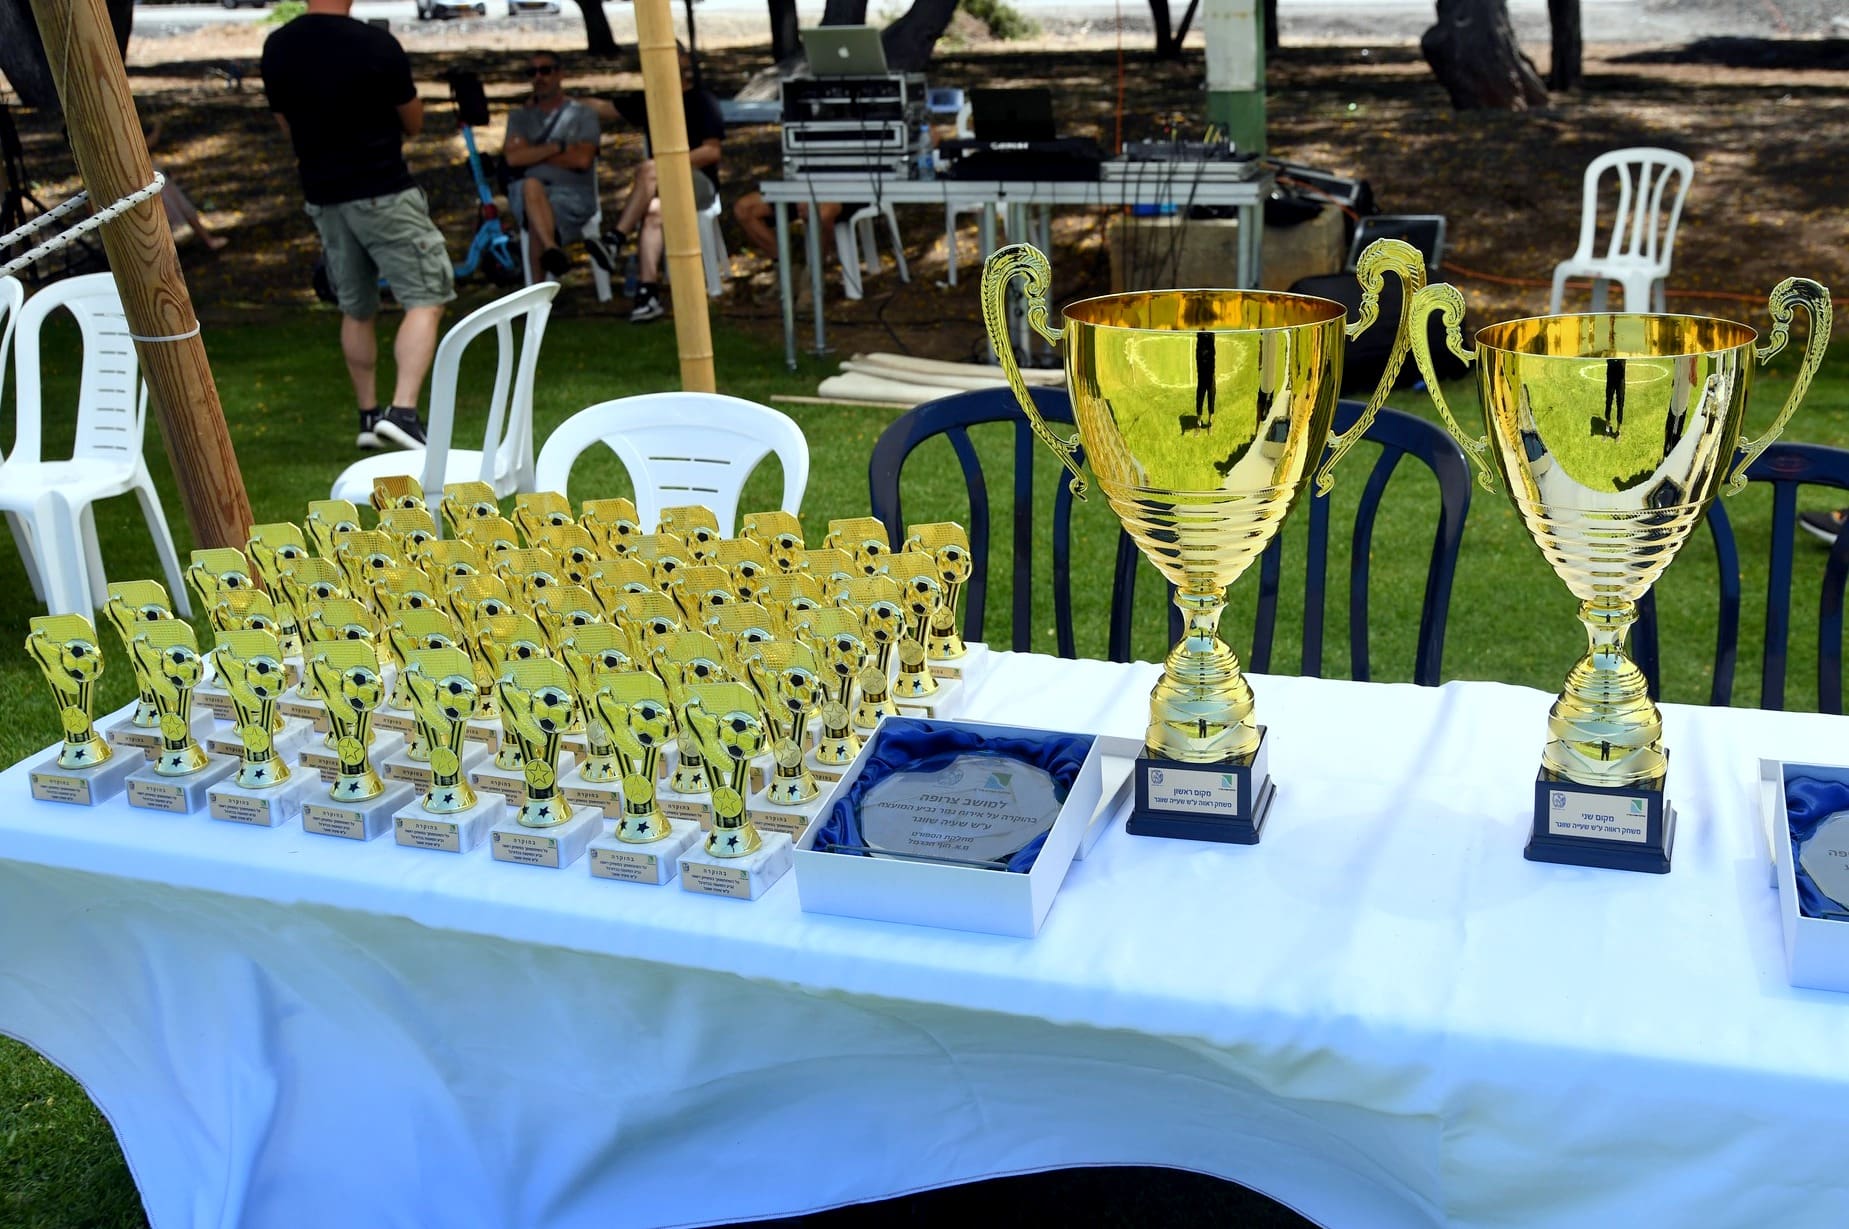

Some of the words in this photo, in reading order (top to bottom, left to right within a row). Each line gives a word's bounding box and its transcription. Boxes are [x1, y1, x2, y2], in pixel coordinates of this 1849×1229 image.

[1173, 788, 1193, 796] ראשון
[1194, 790, 1212, 798] מקום
[920, 794, 960, 804] צרופה
[878, 801, 914, 811] המועצה
[962, 798, 1008, 809] למושב
[915, 805, 937, 813] גביע
[987, 811, 999, 820] על
[1001, 814, 1037, 824] בהוקרה
[1581, 812, 1594, 820] שני
[1596, 815, 1615, 823] מקום
[1621, 827, 1641, 835] משחק
